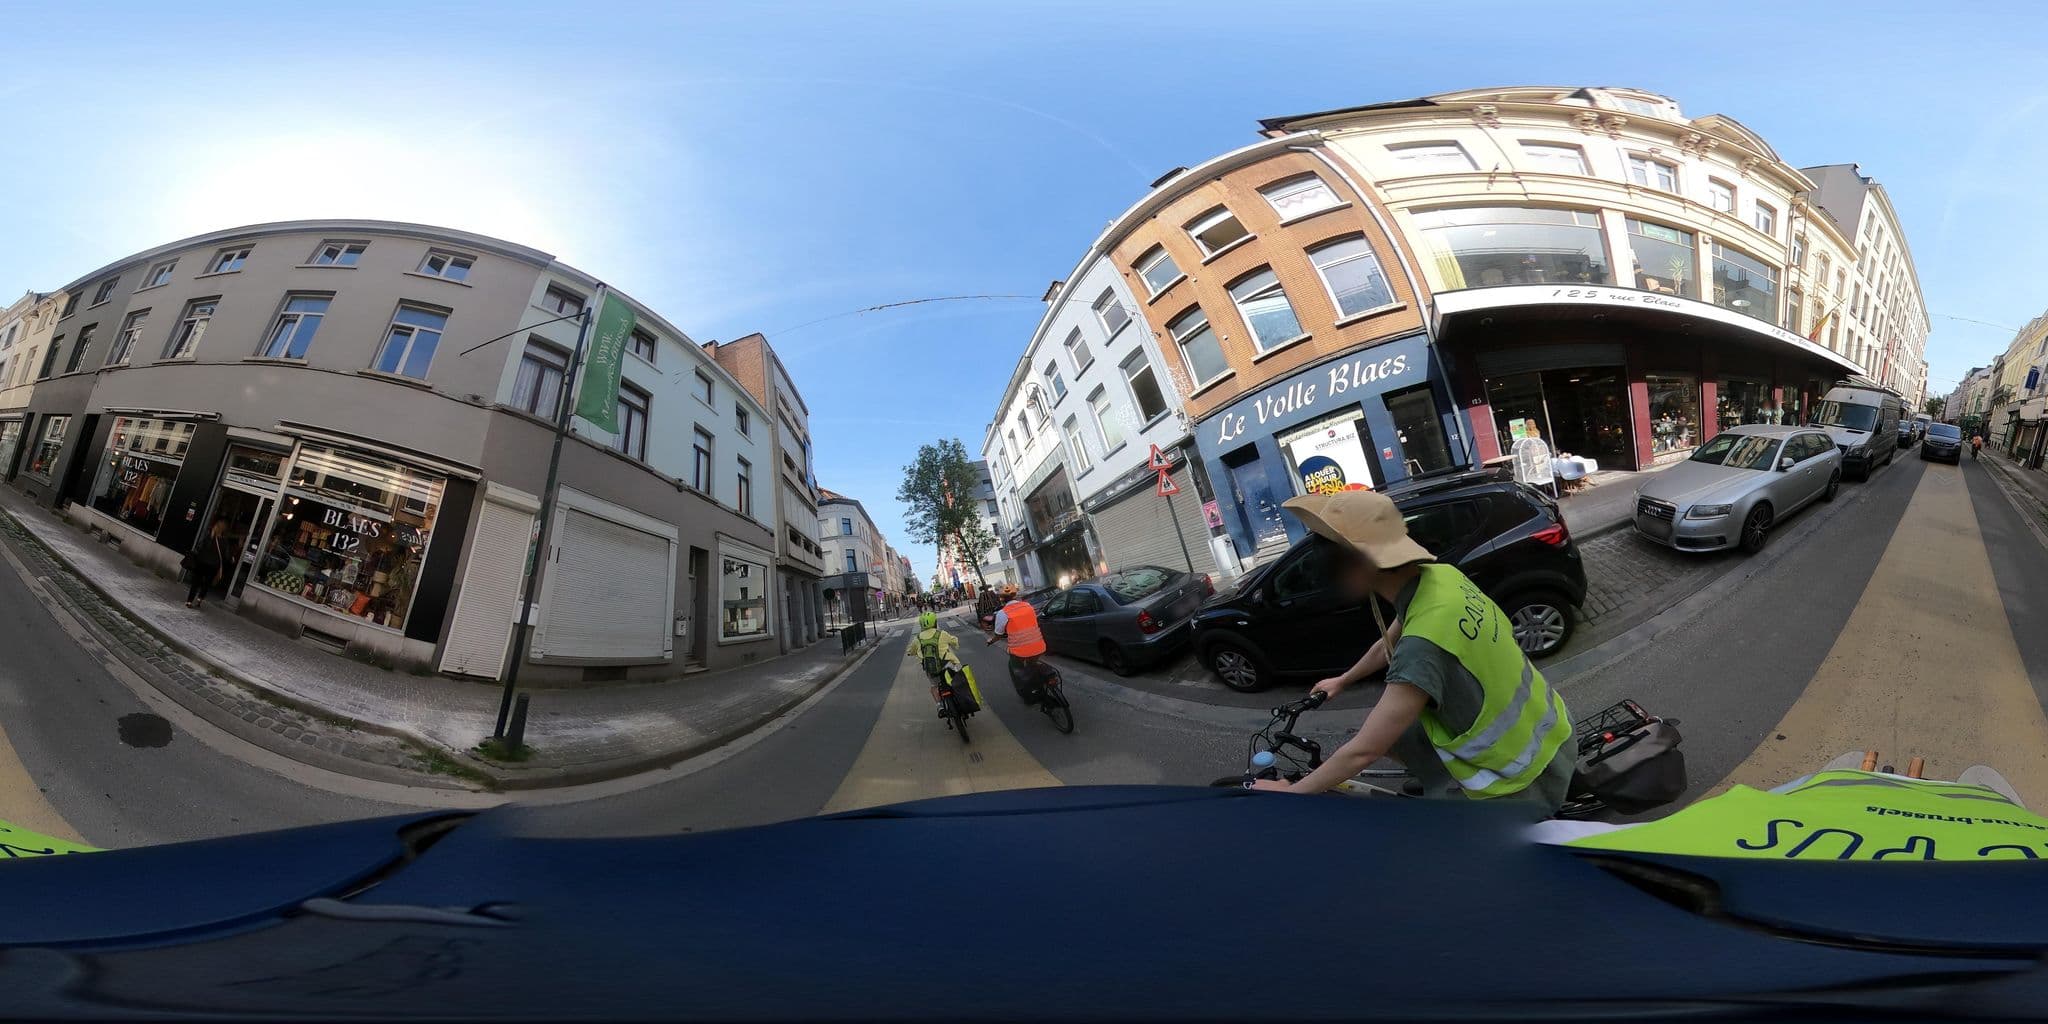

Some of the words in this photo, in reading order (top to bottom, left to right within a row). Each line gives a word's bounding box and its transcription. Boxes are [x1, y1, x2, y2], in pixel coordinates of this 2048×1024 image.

[1552, 289, 1598, 299] 125
[1609, 294, 1636, 302] rue
[1641, 295, 1681, 308] Blaes
[1218, 412, 1246, 445] Le
[1253, 381, 1316, 425] Volle
[1328, 354, 1407, 397] Blaes
[323, 508, 381, 538] BLAES
[332, 532, 360, 553] 132
